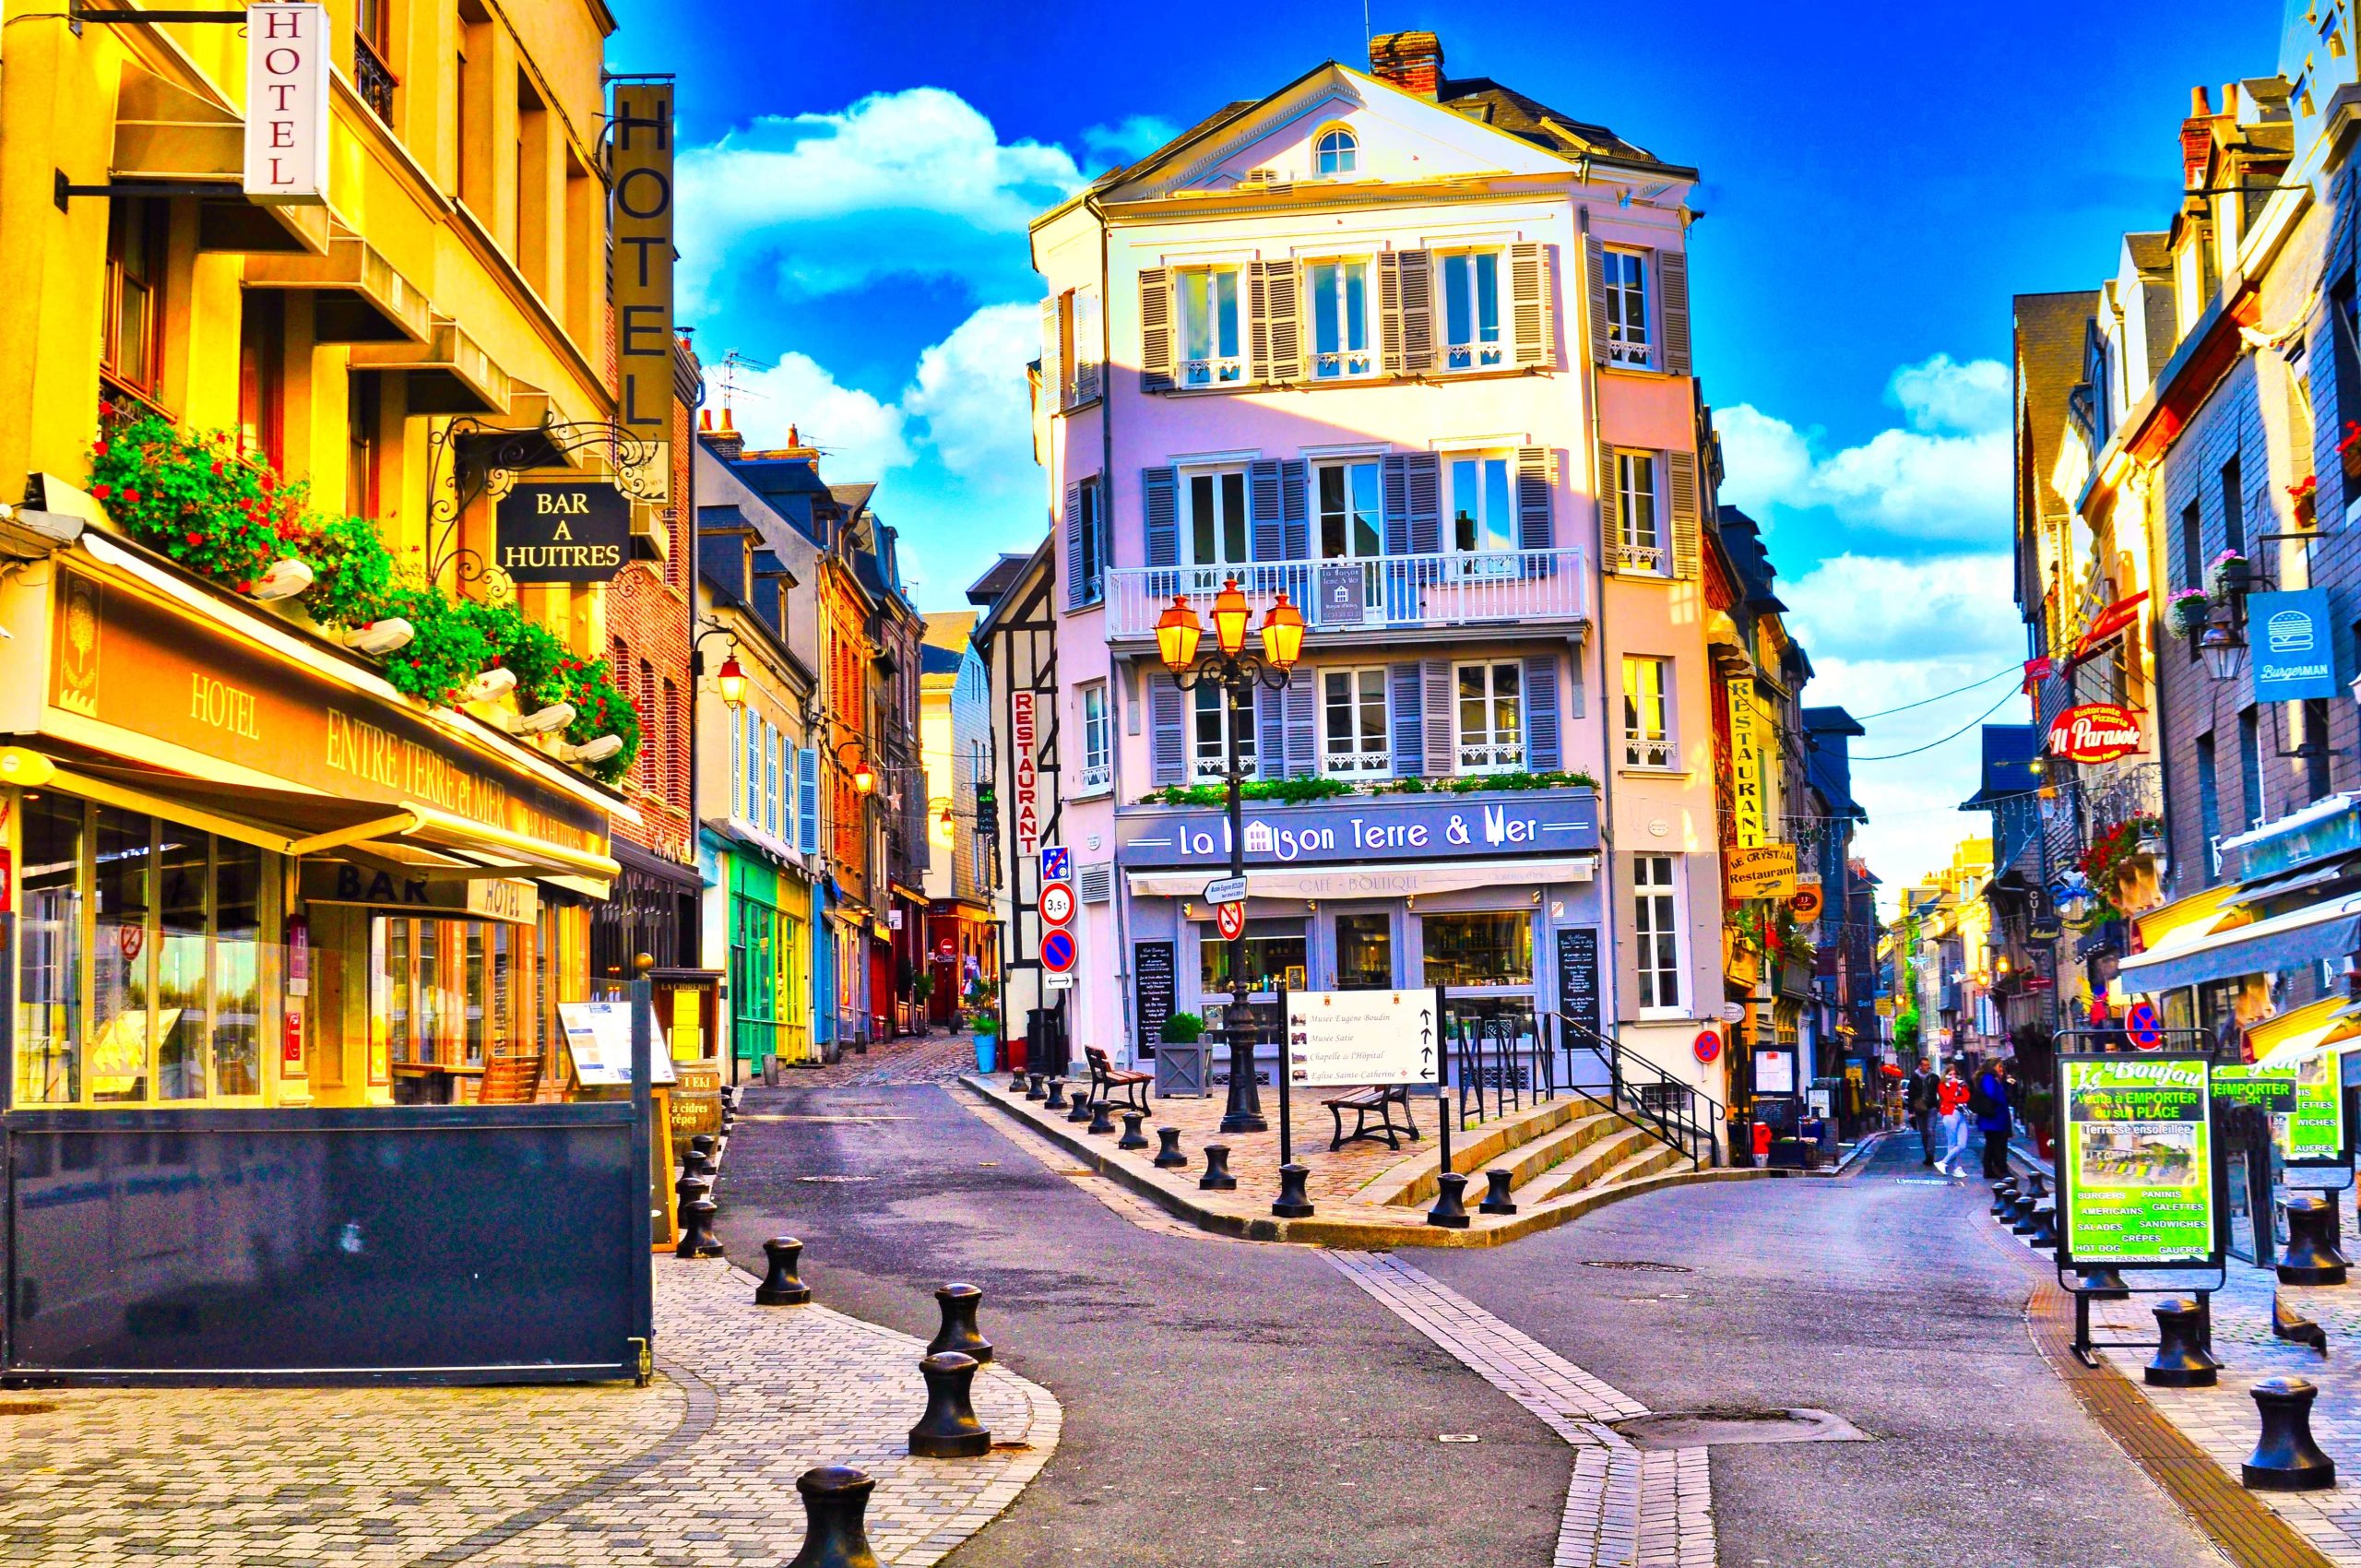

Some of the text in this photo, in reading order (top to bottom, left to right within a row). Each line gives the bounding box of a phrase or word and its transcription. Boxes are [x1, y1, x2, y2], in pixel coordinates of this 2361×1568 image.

[265, 11, 303, 185] HOTEL
[615, 100, 670, 425] HOTEL
[536, 493, 590, 514] BAR
[552, 519, 574, 540] A
[504, 545, 621, 567] HUITRES
[2260, 664, 2329, 680] BurgerMAN
[190, 671, 260, 741] HOTEL
[2073, 707, 2121, 719] Ristorante
[2092, 714, 2129, 728] Pizzeria
[2050, 718, 2141, 754] Il Parasole
[326, 707, 398, 789] ENTRE
[402, 739, 456, 812] TERRE
[457, 774, 472, 817] et
[473, 773, 506, 830] MER
[1732, 682, 1757, 848] RESTAURANT
[1014, 693, 1038, 854] RESTAURANT
[1180, 825, 1215, 855] La
[1350, 817, 1429, 849] Terre
[1446, 814, 1472, 845] &
[1484, 804, 1536, 847] Mer
[1730, 849, 1793, 870] LE CRYSTAL
[1729, 865, 1795, 884] Restaurant
[1348, 875, 1418, 892] BOUTIQUE
[336, 864, 520, 918] BAR HOTEL
[661, 982, 672, 992] LA
[1311, 1014, 1391, 1025] Musée Eugène Boudin
[1311, 1034, 1355, 1042] Musée Satie
[1310, 1052, 1341, 1063] Chapelle
[1335, 1069, 1396, 1079] Sainte-Catherine
[2078, 1092, 2198, 1104] Vente à EMPORTER
[671, 1102, 708, 1113] à cidres
[2094, 1106, 2180, 1119] ou sur PLACE
[670, 1112, 697, 1126] rêpes
[2084, 1123, 2192, 1134] Terrasse ensoleillée
[2295, 1144, 2335, 1152] AUFRES
[2078, 1192, 2126, 1200] BURGERS
[2081, 1207, 2144, 1216] AMERICAINS
[2152, 1203, 2204, 1211] GALETTES
[2077, 1223, 2123, 1231] SALADES
[2099, 1244, 2121, 1253] DOG
[2159, 1246, 2205, 1254] GAUFRES
